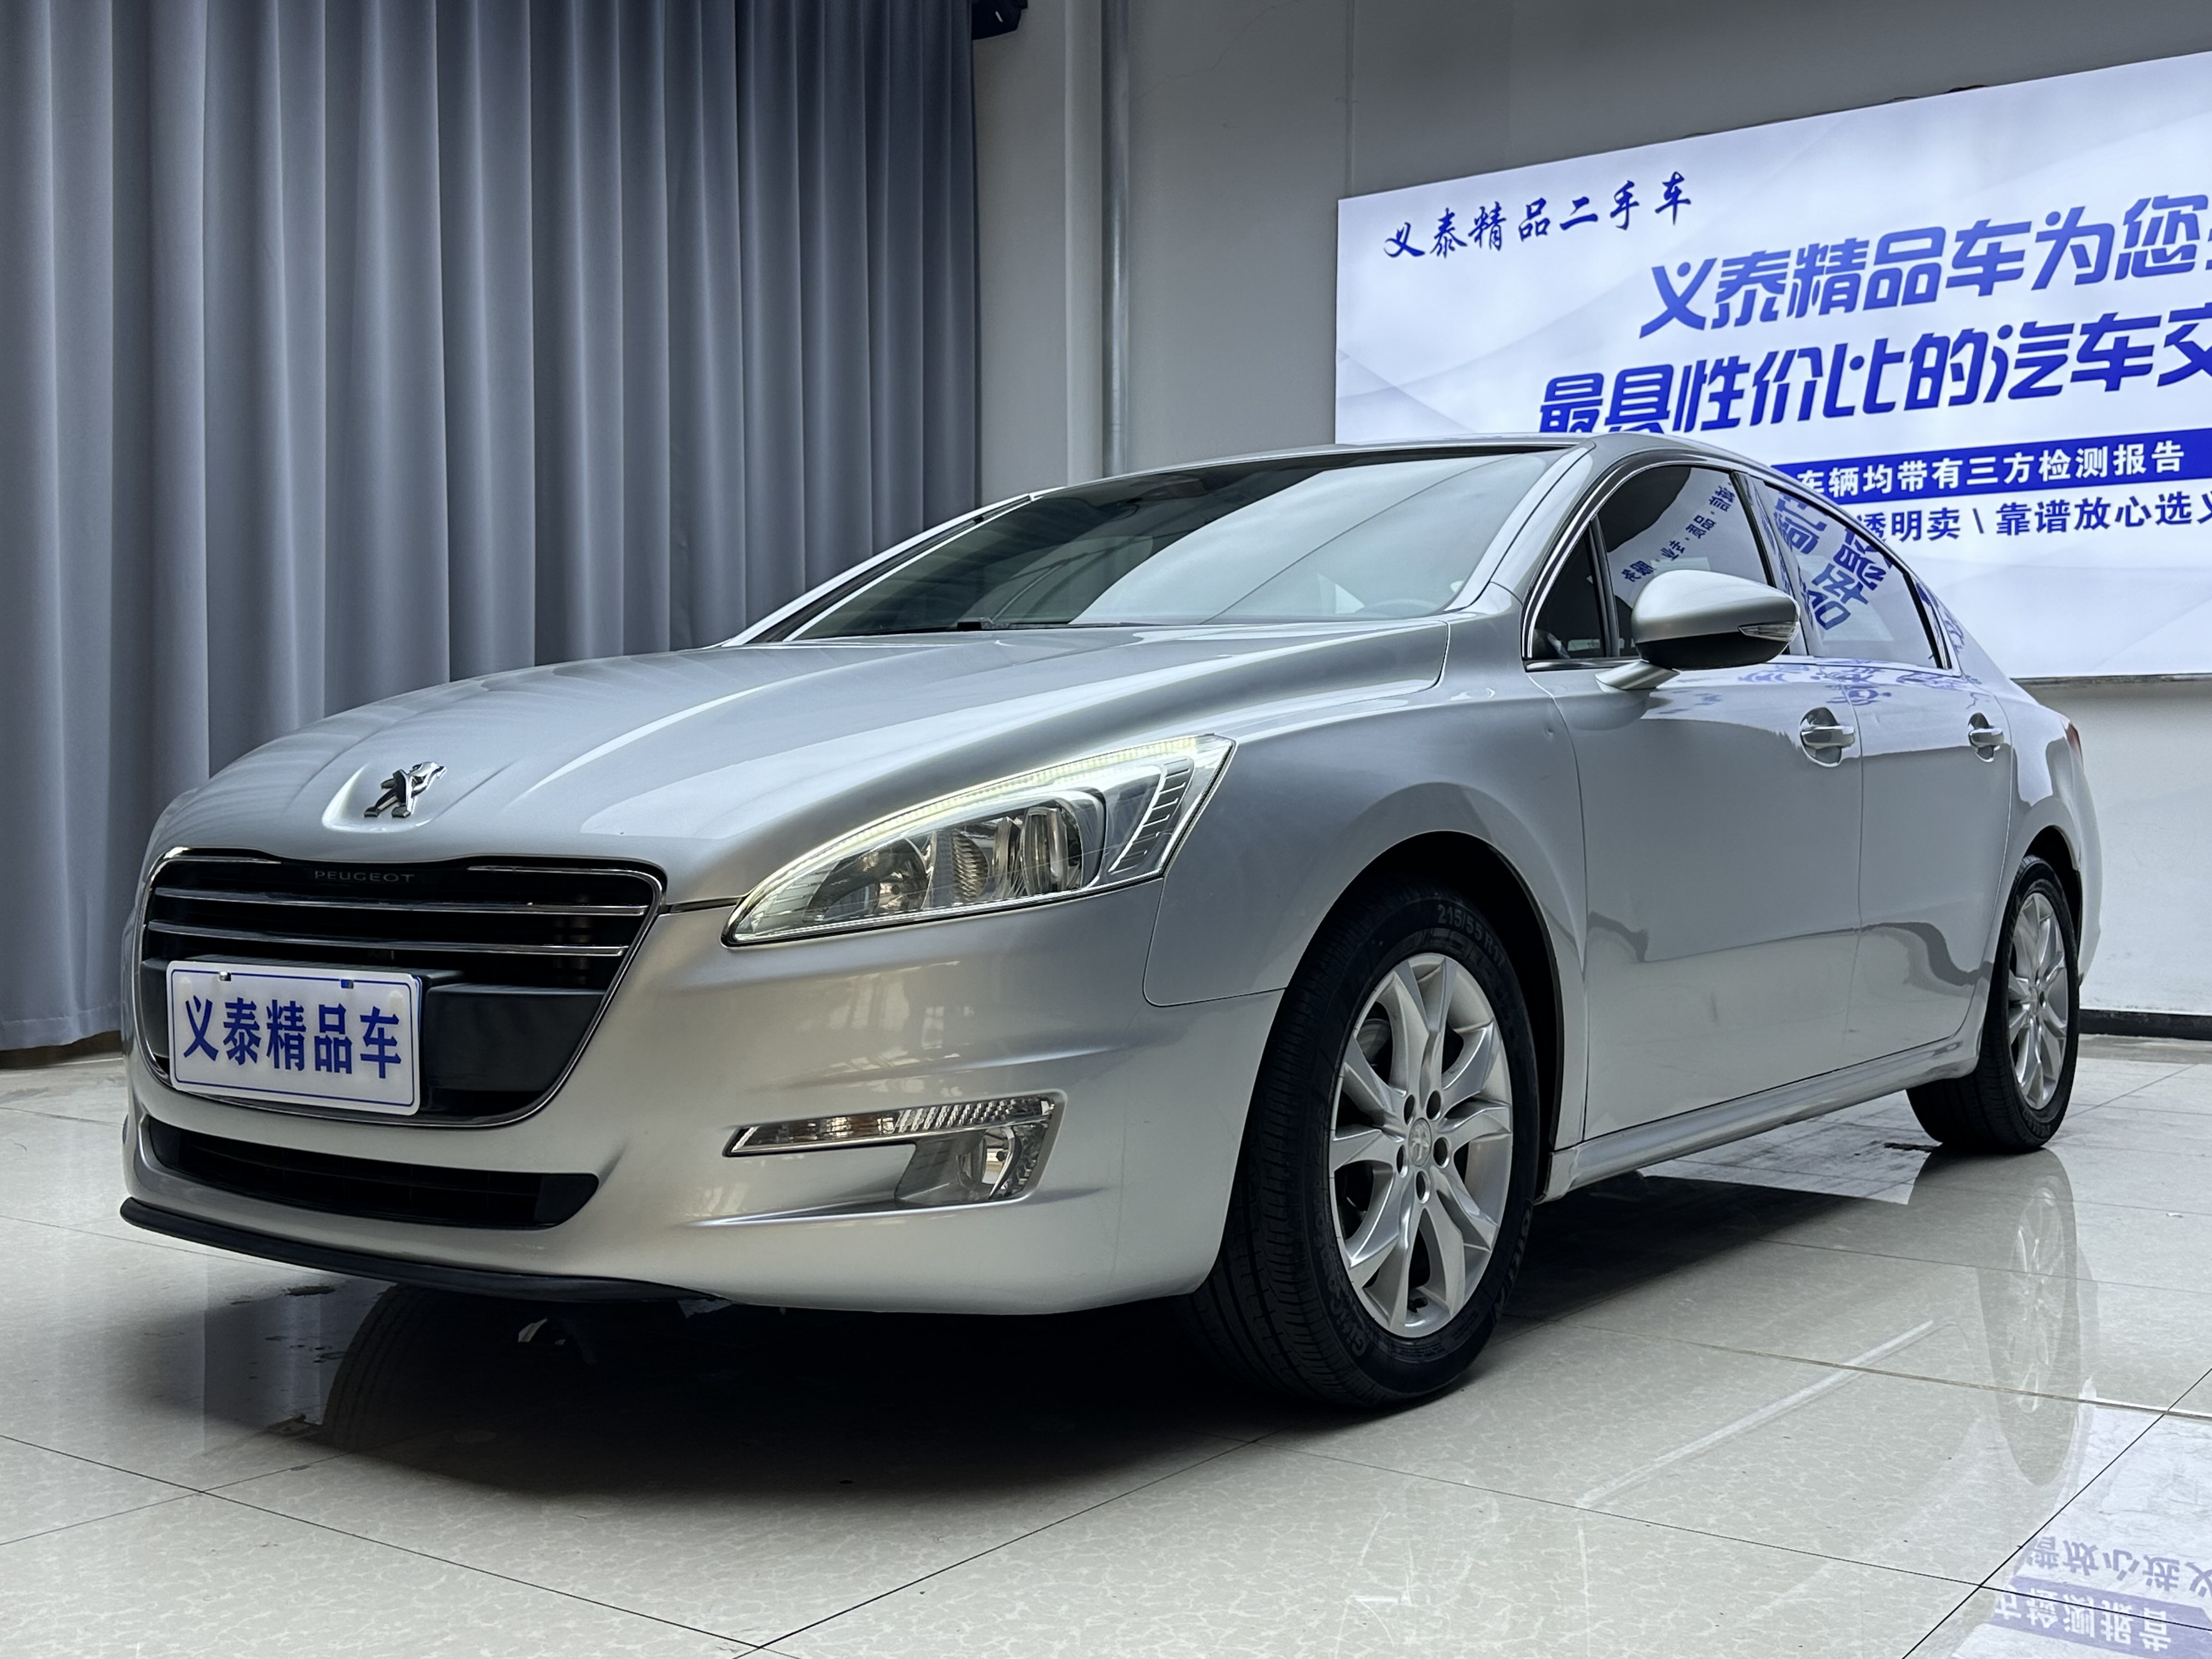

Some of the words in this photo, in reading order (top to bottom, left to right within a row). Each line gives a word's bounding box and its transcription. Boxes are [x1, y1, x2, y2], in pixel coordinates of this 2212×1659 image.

[1384, 171, 1691, 259] 义泰精品二手车
[1639, 194, 2212, 338] 义泰精品车为您
[314, 870, 415, 883] PEUGEOT
[1438, 904, 1486, 944] 215/55
[183, 995, 402, 1080] 义泰精品车
